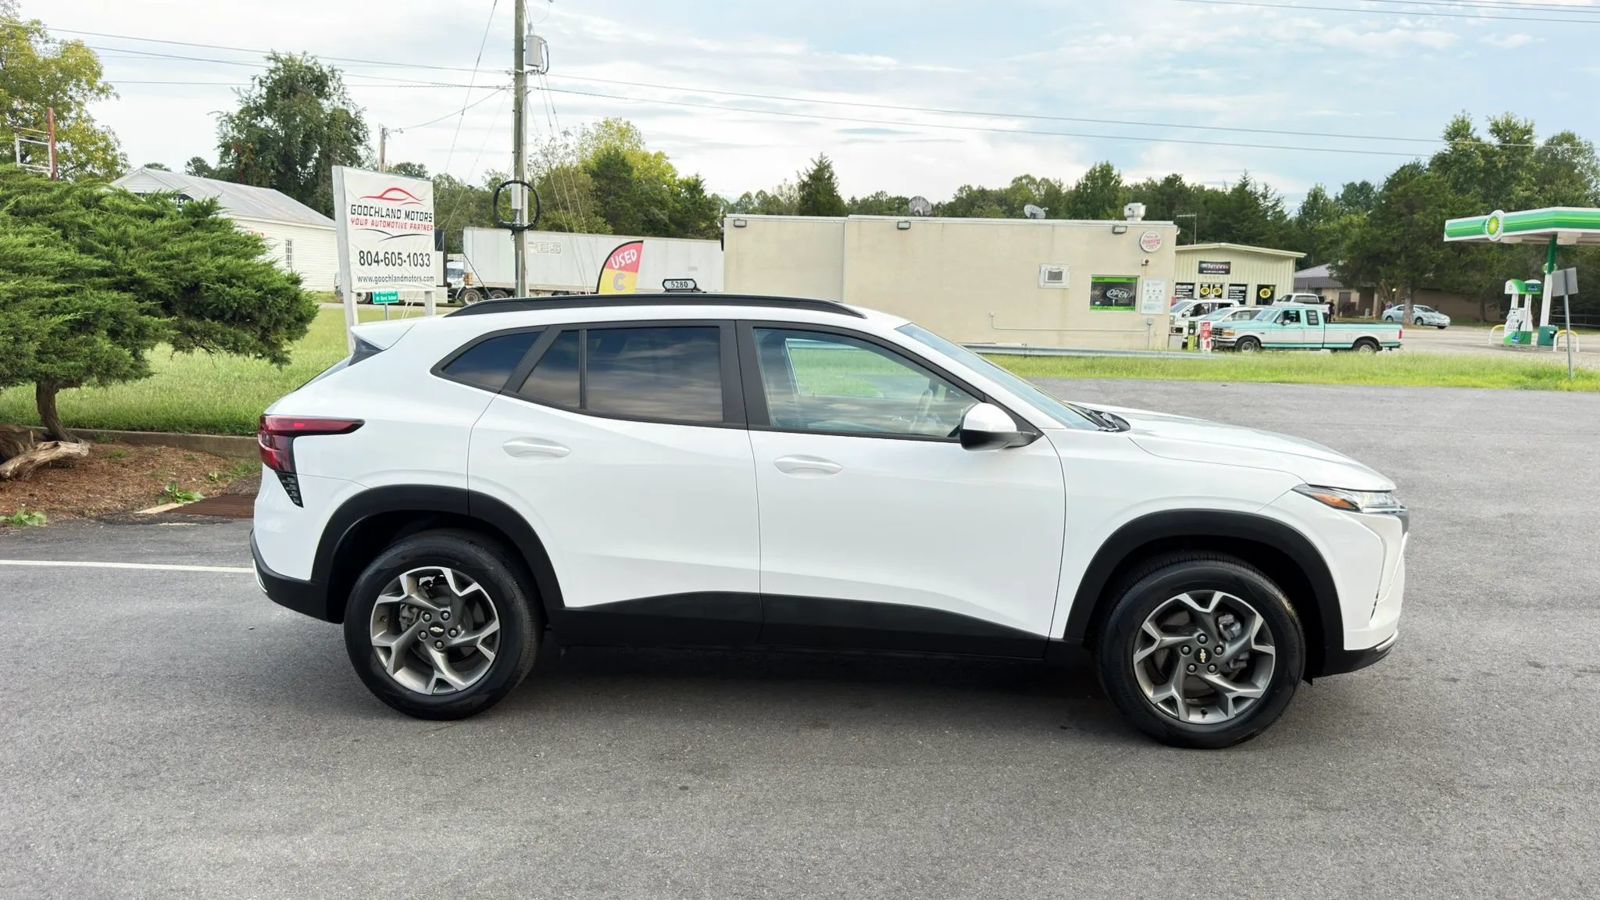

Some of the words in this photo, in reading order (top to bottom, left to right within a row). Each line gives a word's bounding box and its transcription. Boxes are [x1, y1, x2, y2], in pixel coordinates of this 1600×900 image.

[350, 204, 402, 219] GOOCHLAND
[405, 210, 433, 222] MOTORS
[351, 217, 368, 226] YOUR
[371, 219, 408, 229] AUTOMOTIVE
[409, 223, 433, 232] PARTNER
[358, 249, 431, 267] 804-605-1033
[610, 248, 638, 269] USED
[357, 273, 435, 284] www.goochlandmotors.com
[613, 272, 626, 291] C
